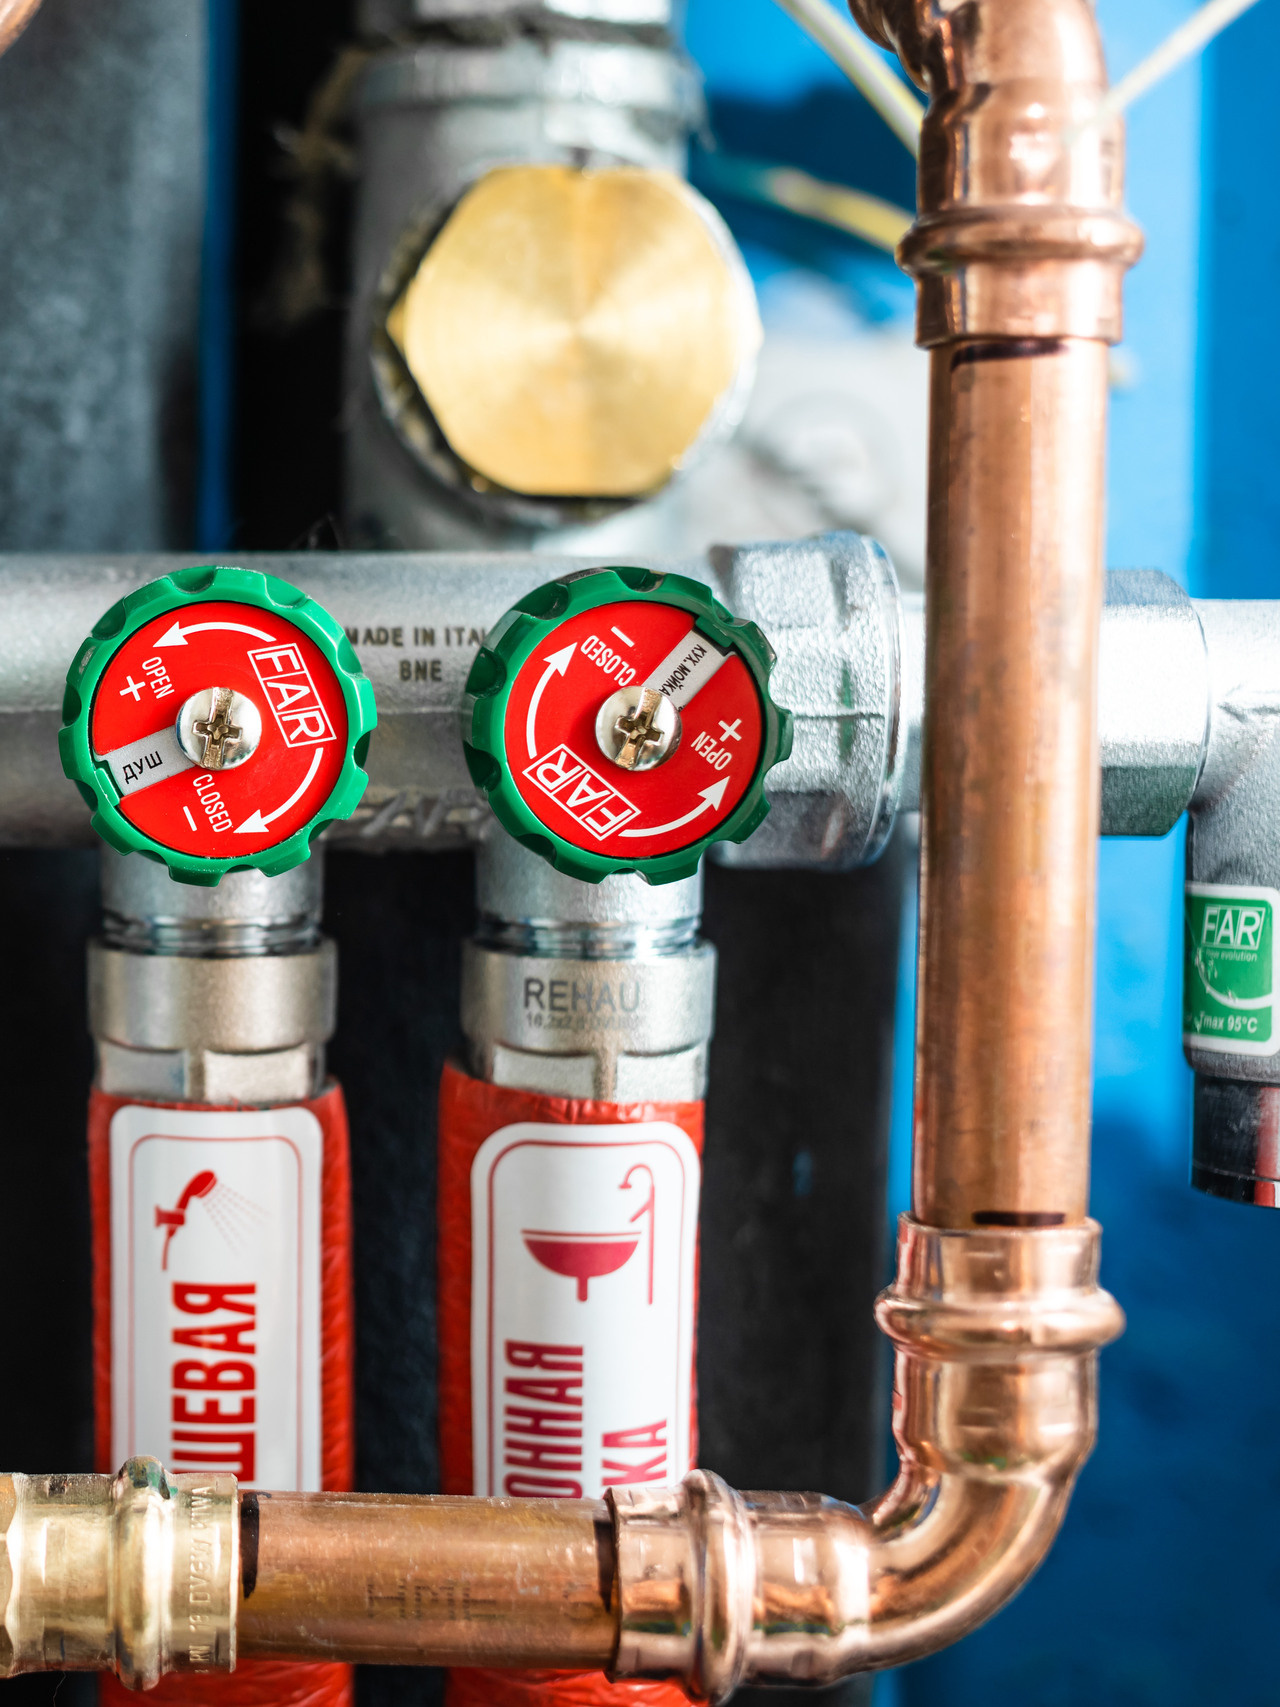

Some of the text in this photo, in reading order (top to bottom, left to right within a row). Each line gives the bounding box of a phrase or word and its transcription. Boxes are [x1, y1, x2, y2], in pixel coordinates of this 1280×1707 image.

[346, 627, 403, 647] MADE
[414, 627, 435, 647] IN
[141, 656, 175, 701] OPEN
[580, 634, 637, 687] CLOSED
[657, 643, 708, 698] КУХ. МОЙКА
[253, 646, 328, 743] FAR
[122, 751, 164, 785] ДУШ
[690, 730, 733, 772] OPEN
[192, 773, 233, 834] CLOSED
[533, 749, 633, 835] FAR
[1202, 907, 1264, 948] FAR
[523, 977, 640, 1012] REHAU
[1227, 1013, 1259, 1034] 95°C
